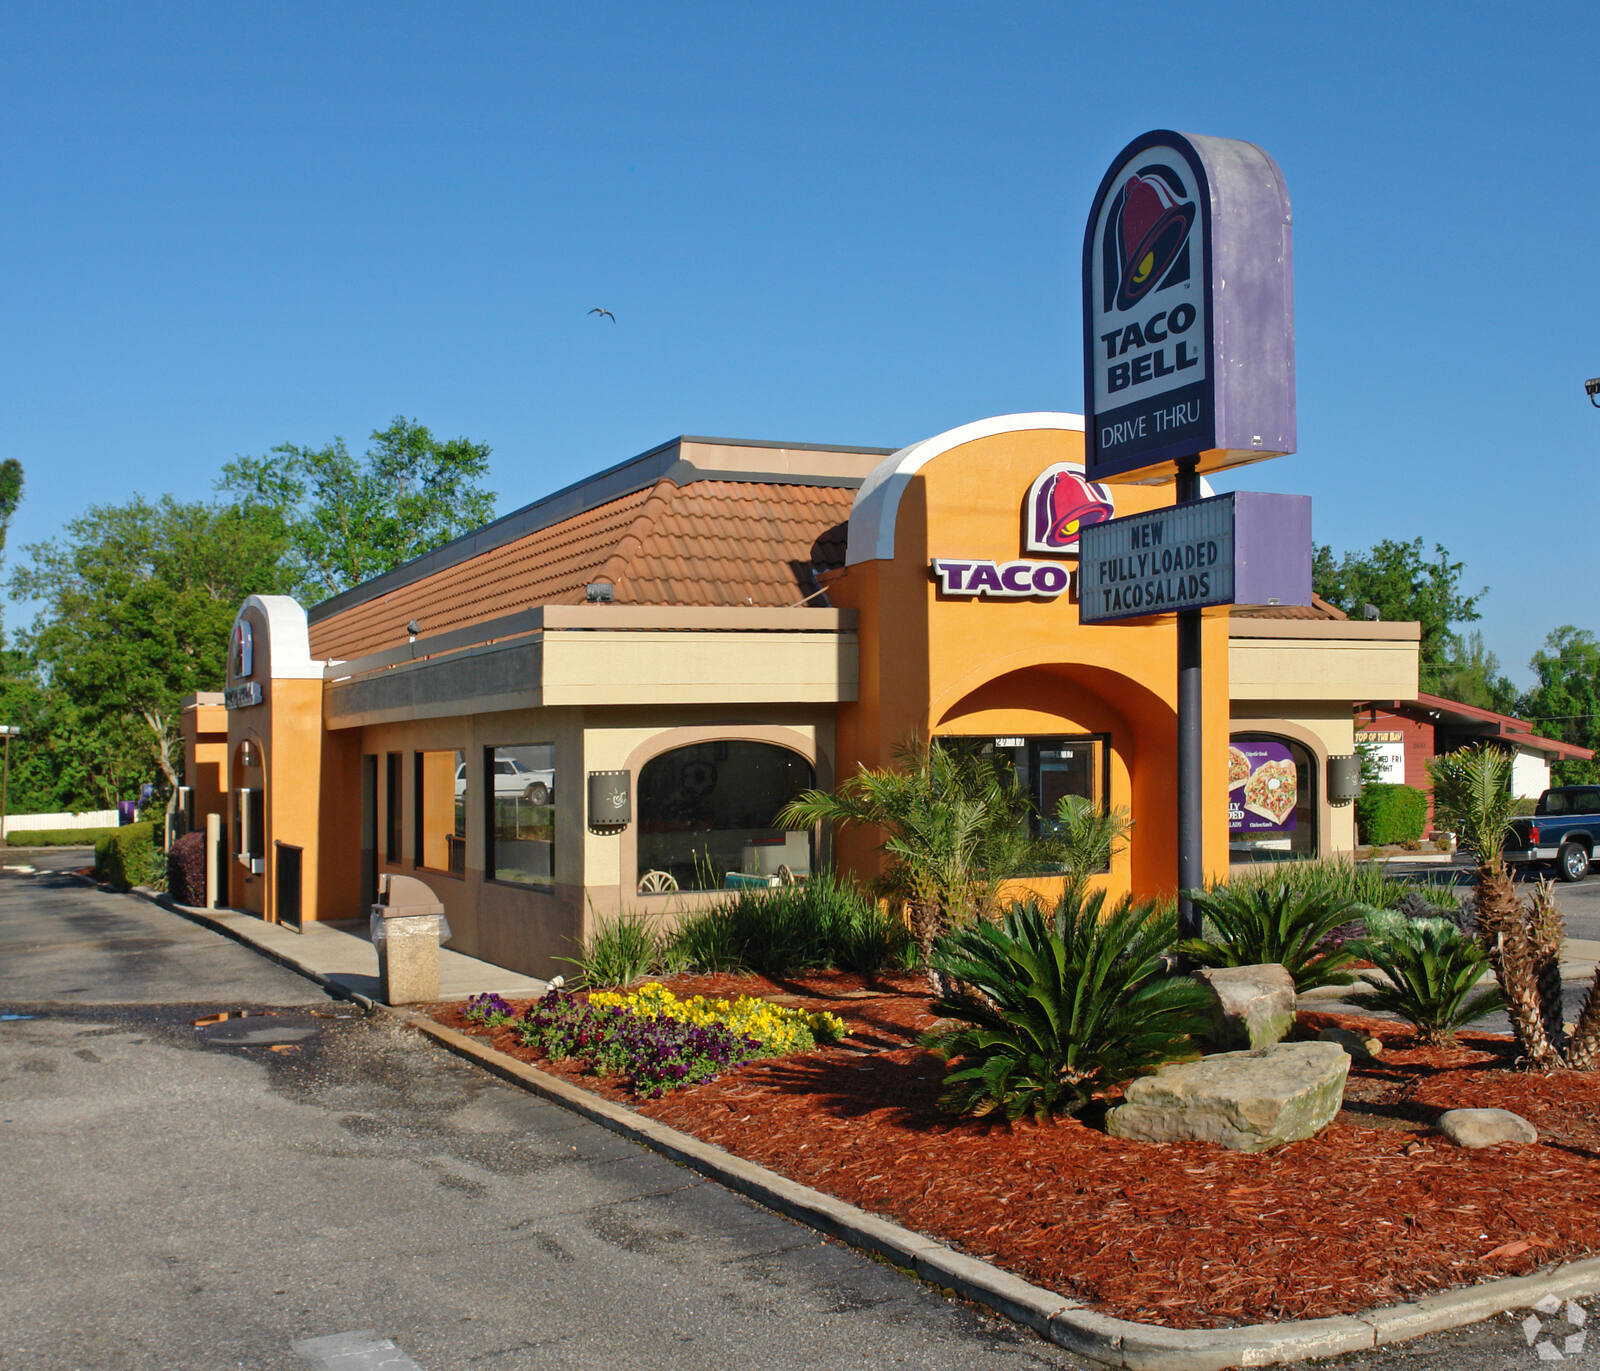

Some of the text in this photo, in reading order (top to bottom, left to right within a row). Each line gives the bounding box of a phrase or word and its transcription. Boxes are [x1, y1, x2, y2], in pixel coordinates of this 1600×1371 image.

[1100, 303, 1197, 360] TACO
[1107, 341, 1199, 394] BELL
[1102, 399, 1200, 449] DRIVE THRU
[1131, 520, 1163, 549] NEW
[938, 563, 1068, 592] TACO
[1355, 732, 1368, 743] TOP
[1369, 732, 1377, 742] OF
[1378, 732, 1389, 742] THE
[1392, 755, 1402, 763] FRI
